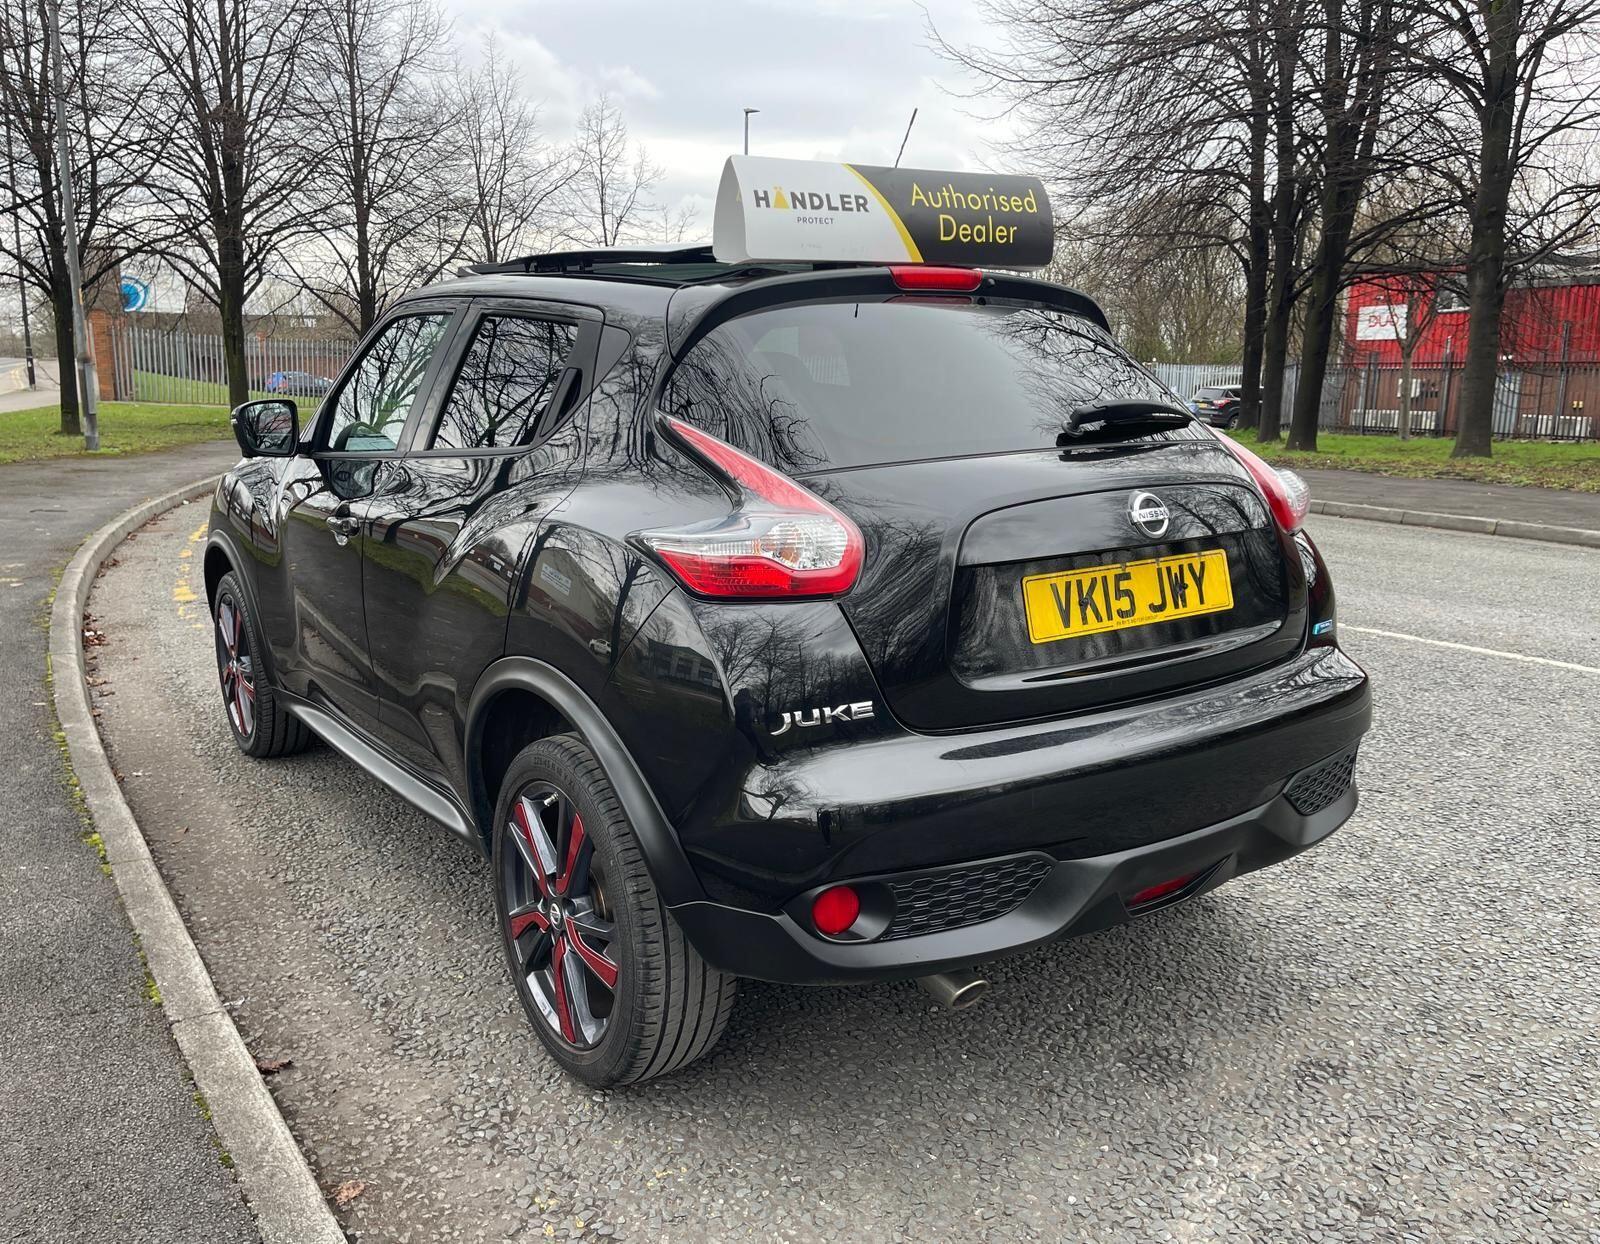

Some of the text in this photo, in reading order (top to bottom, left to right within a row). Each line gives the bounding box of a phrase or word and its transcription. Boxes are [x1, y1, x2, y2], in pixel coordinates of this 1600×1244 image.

[911, 182, 1039, 214] Authorised
[797, 216, 835, 225] PROTECT
[939, 214, 1018, 244] Dealer
[1139, 509, 1169, 519] NISSAN
[1050, 561, 1206, 629] VK15 JWY
[770, 701, 875, 736] JUKE
